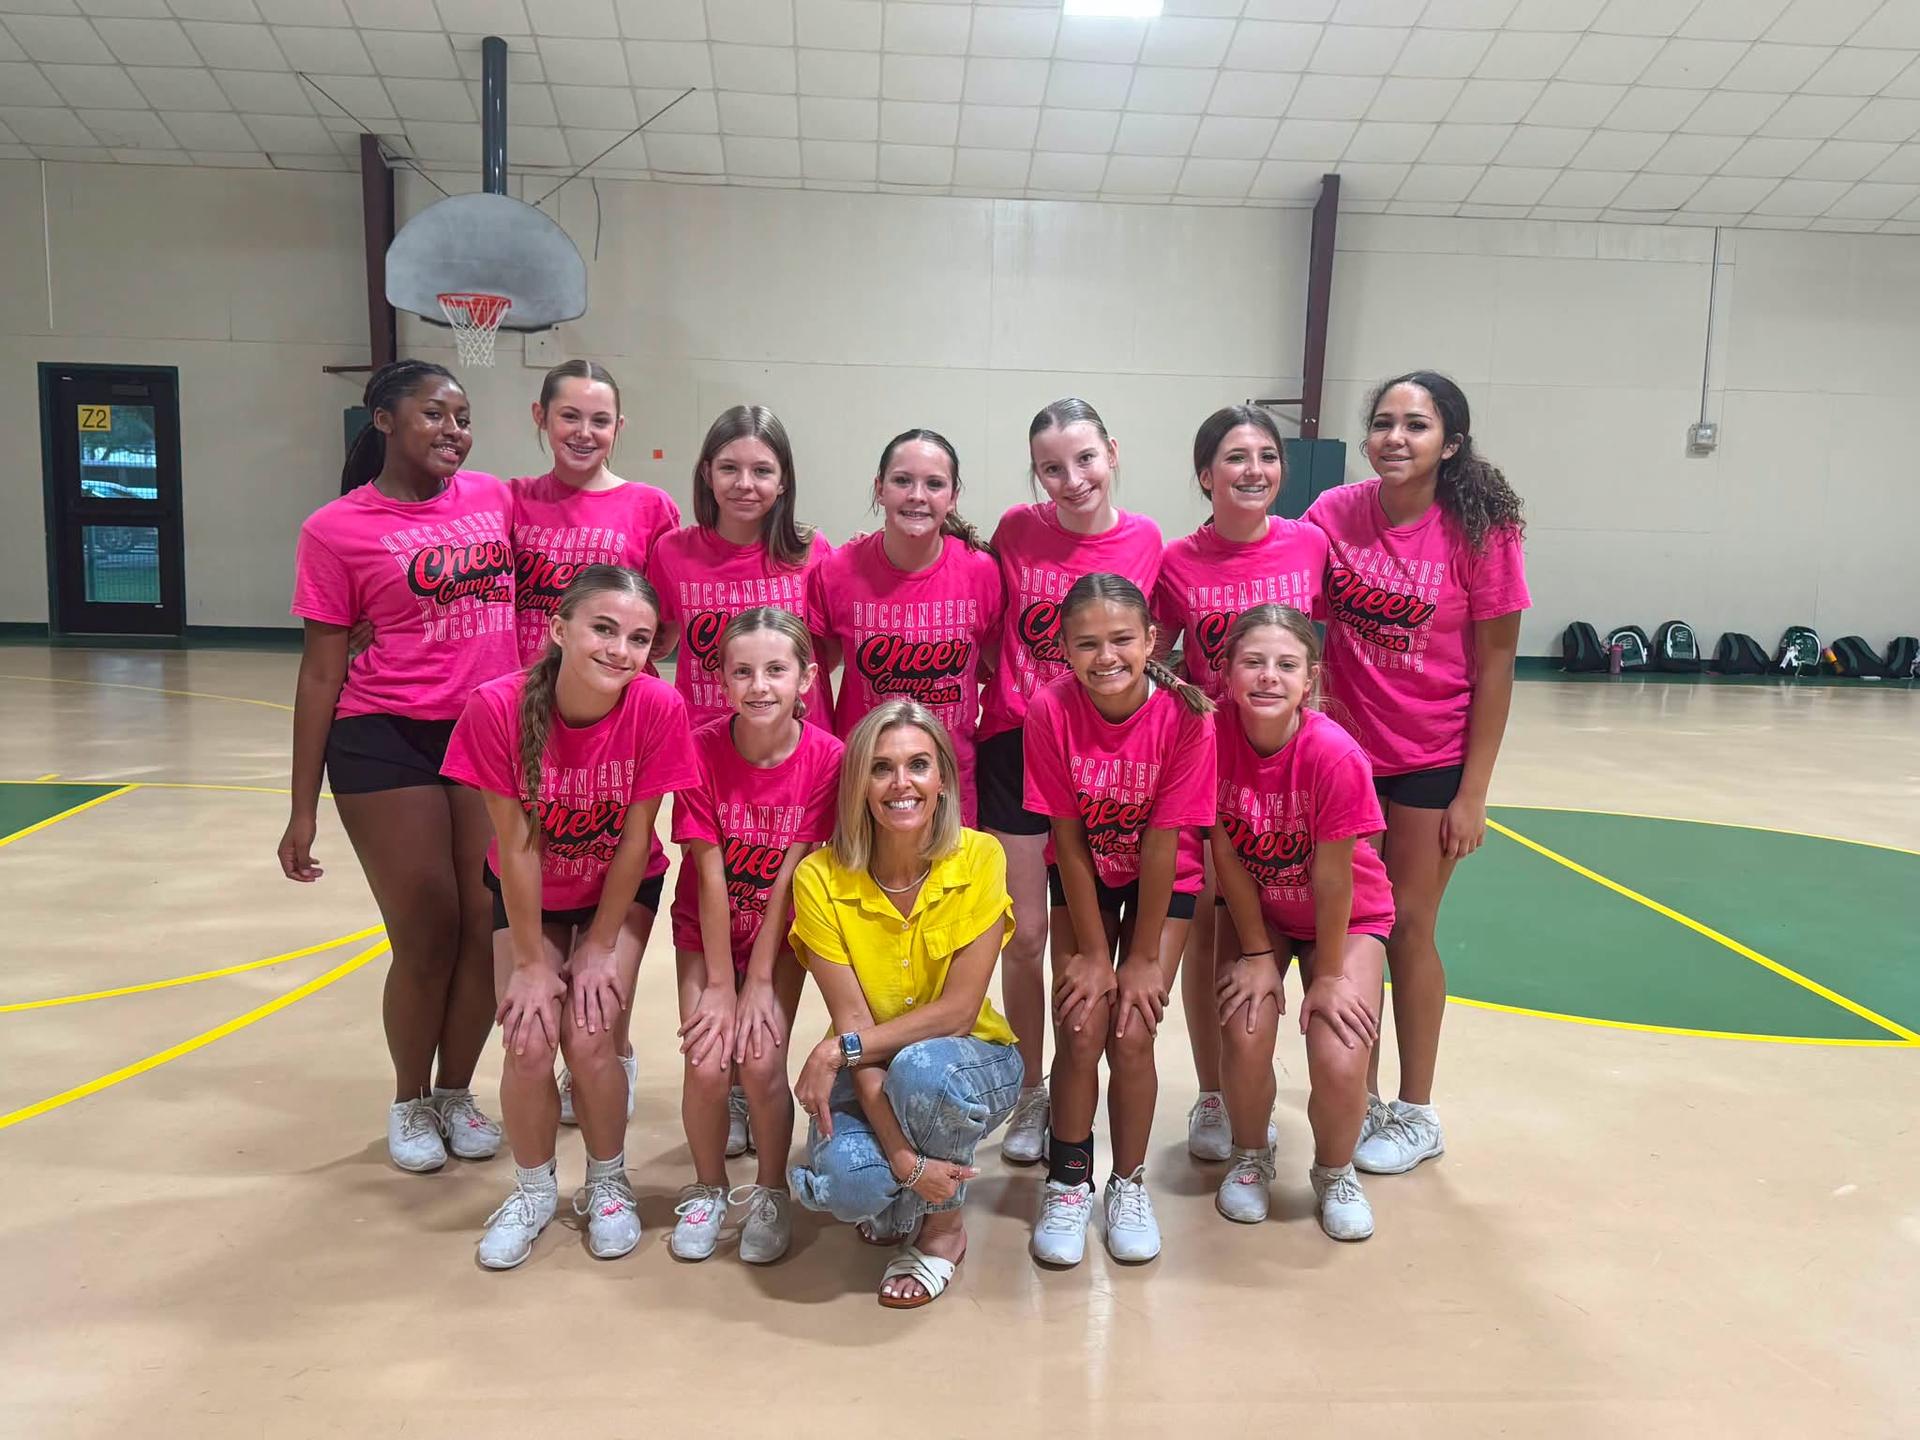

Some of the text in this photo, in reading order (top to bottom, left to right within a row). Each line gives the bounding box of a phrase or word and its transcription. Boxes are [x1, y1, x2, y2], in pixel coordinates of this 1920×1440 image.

[81, 408, 107, 429] Z2
[514, 524, 627, 553] UCCANEERS
[408, 540, 514, 597] Cheer
[516, 550, 590, 594] Che
[680, 574, 804, 606] BUCCANEERS
[1328, 567, 1437, 628] Cheer
[853, 600, 977, 629] BUCCANEERS
[856, 634, 972, 679] Cheer
[1361, 630, 1410, 653] 2026
[872, 671, 934, 696] Camp
[914, 685, 961, 704] 2026
